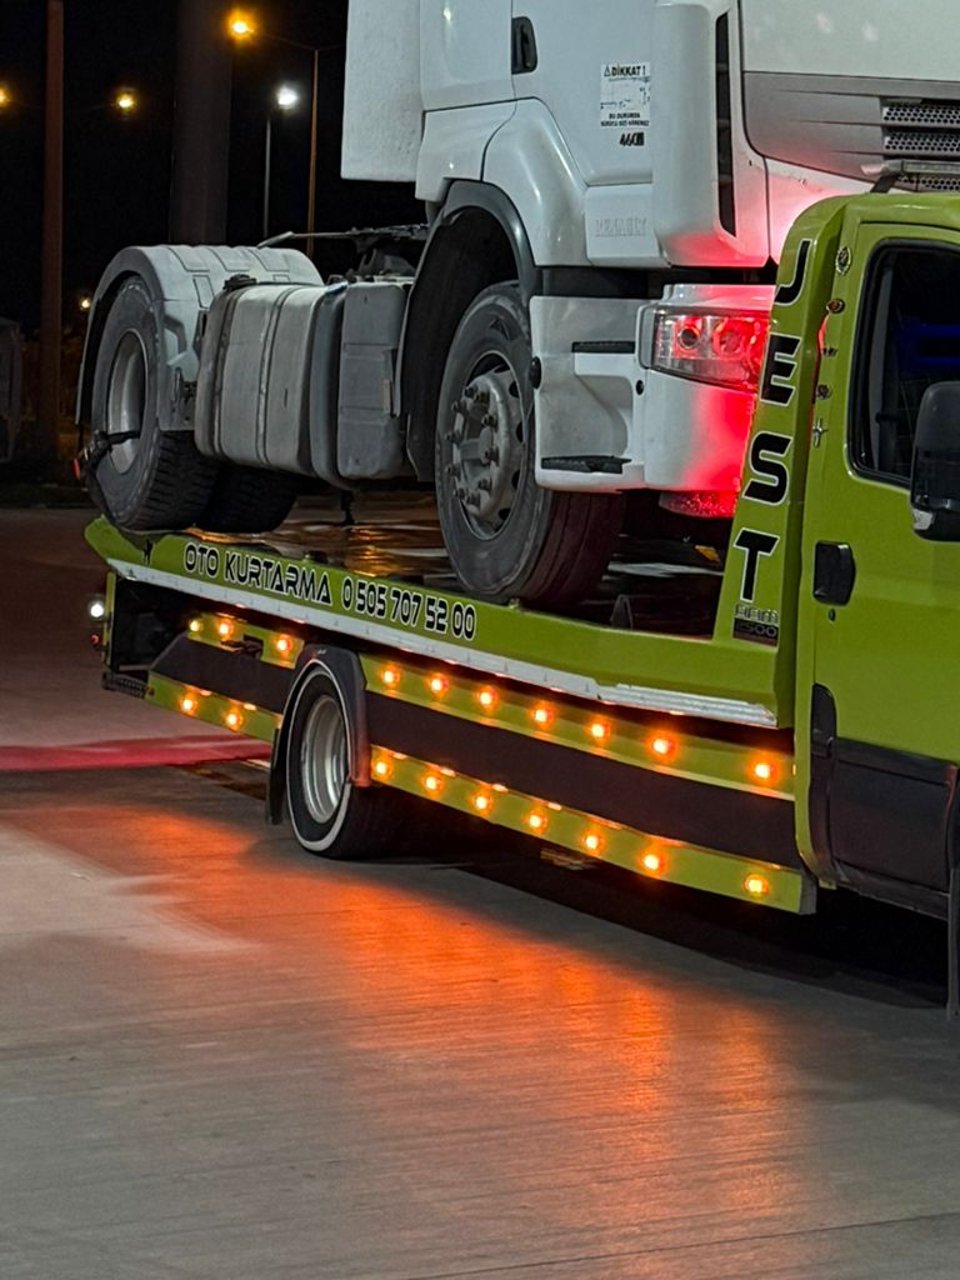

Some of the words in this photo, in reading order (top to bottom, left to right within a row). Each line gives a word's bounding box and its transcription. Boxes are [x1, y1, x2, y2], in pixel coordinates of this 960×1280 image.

[733, 238, 812, 603] JEST
[184, 541, 220, 578] OTO
[223, 550, 333, 606] KURTARMA
[341, 575, 354, 611] 0
[356, 579, 388, 620] 505
[390, 586, 422, 627] 707
[424, 595, 450, 636] 52
[450, 600, 477, 642] 00
